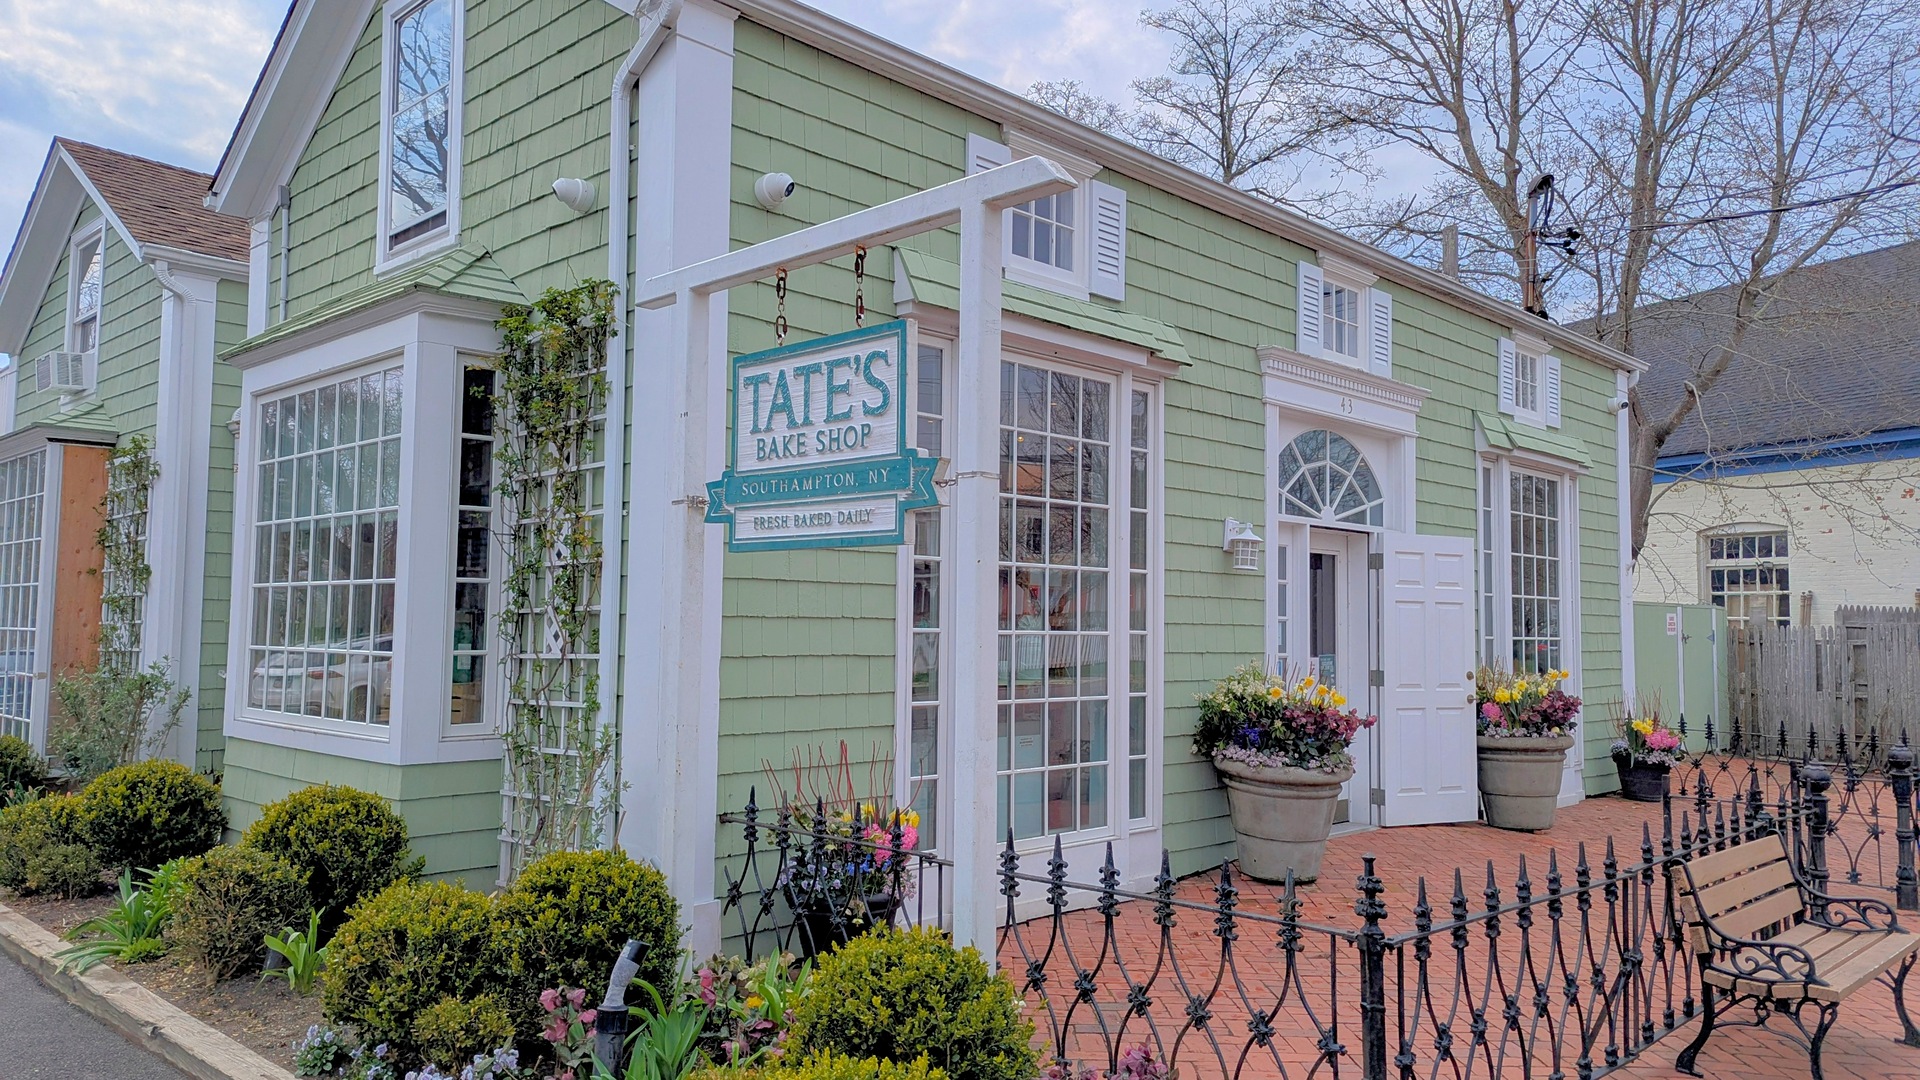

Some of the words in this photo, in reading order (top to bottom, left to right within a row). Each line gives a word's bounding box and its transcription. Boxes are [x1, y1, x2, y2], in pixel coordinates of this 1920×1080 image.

[743, 349, 891, 434] TATE'S
[1341, 397, 1353, 415] 43
[756, 432, 807, 461] BAKE
[815, 423, 872, 452] SHOP
[741, 474, 859, 496] SOUTHAMPTON,
[868, 468, 891, 483] NY
[753, 514, 788, 530] FRESH
[793, 511, 832, 527] BAKED
[837, 509, 872, 524] DAILY
